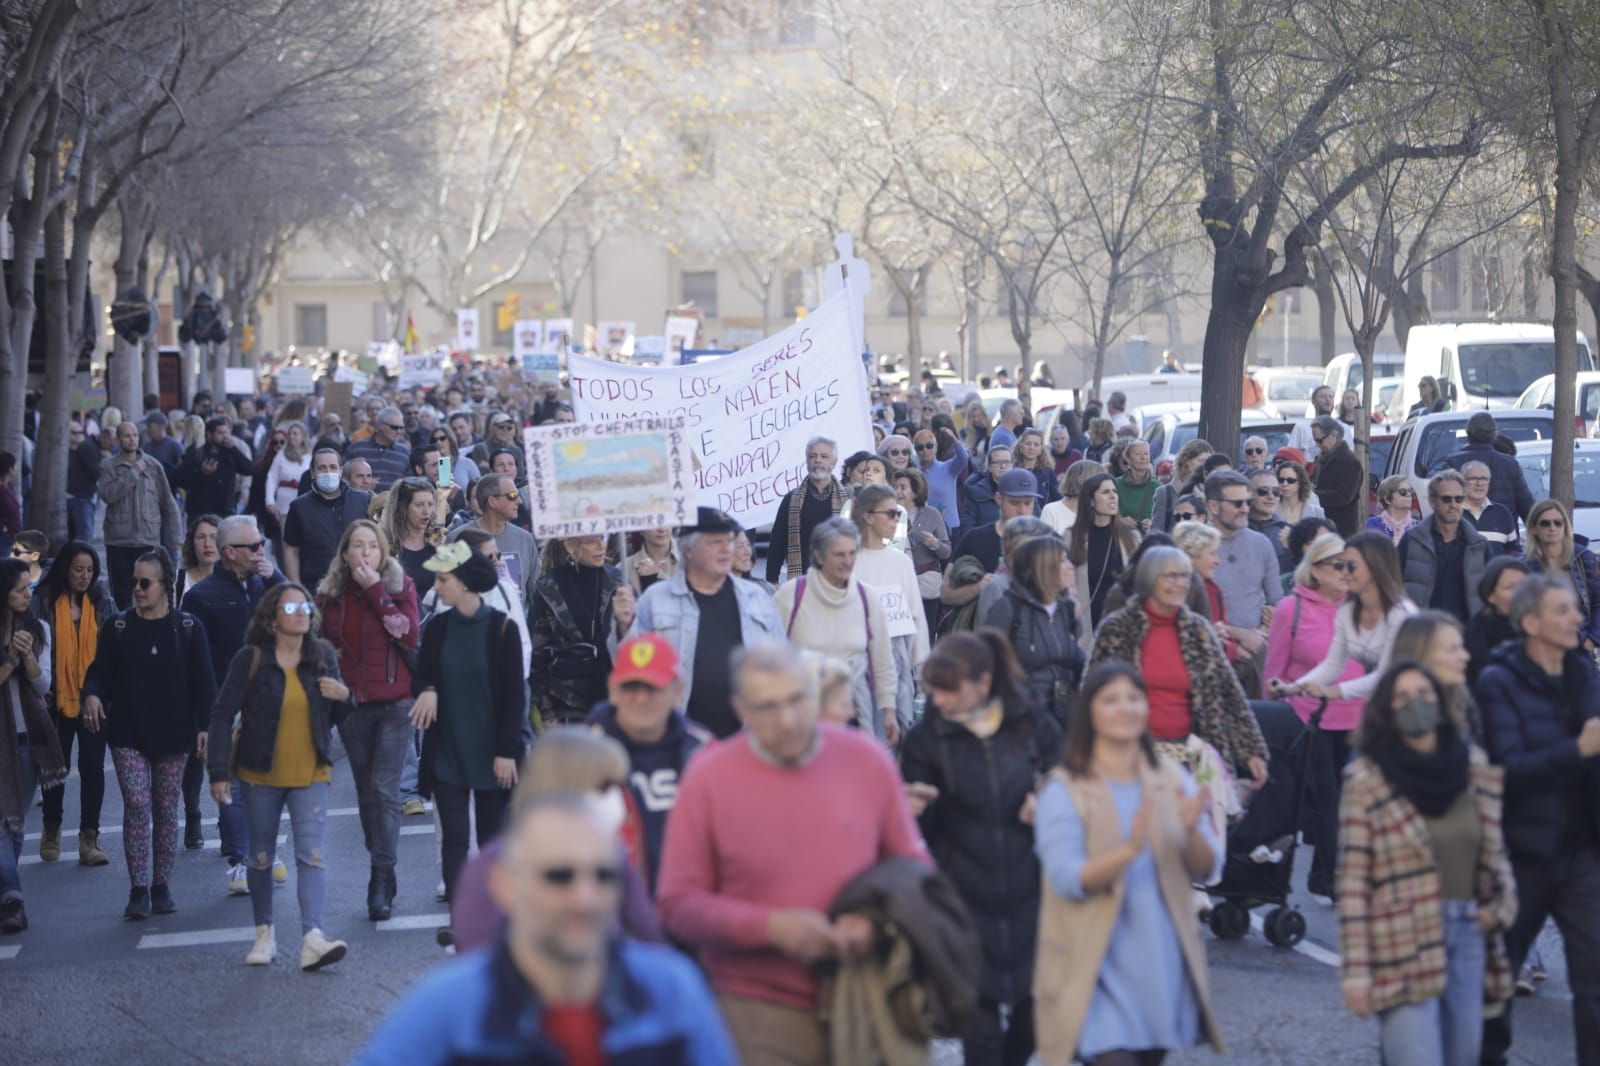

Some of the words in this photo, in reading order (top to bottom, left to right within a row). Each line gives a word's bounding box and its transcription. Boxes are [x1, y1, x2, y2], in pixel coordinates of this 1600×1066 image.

[573, 377, 656, 401] TODOS
[679, 376, 722, 400] LOS
[724, 366, 802, 416] NACEN
[743, 378, 840, 444] IGUALES
[551, 424, 588, 440] STOP
[693, 440, 781, 491] IGNIDAD
